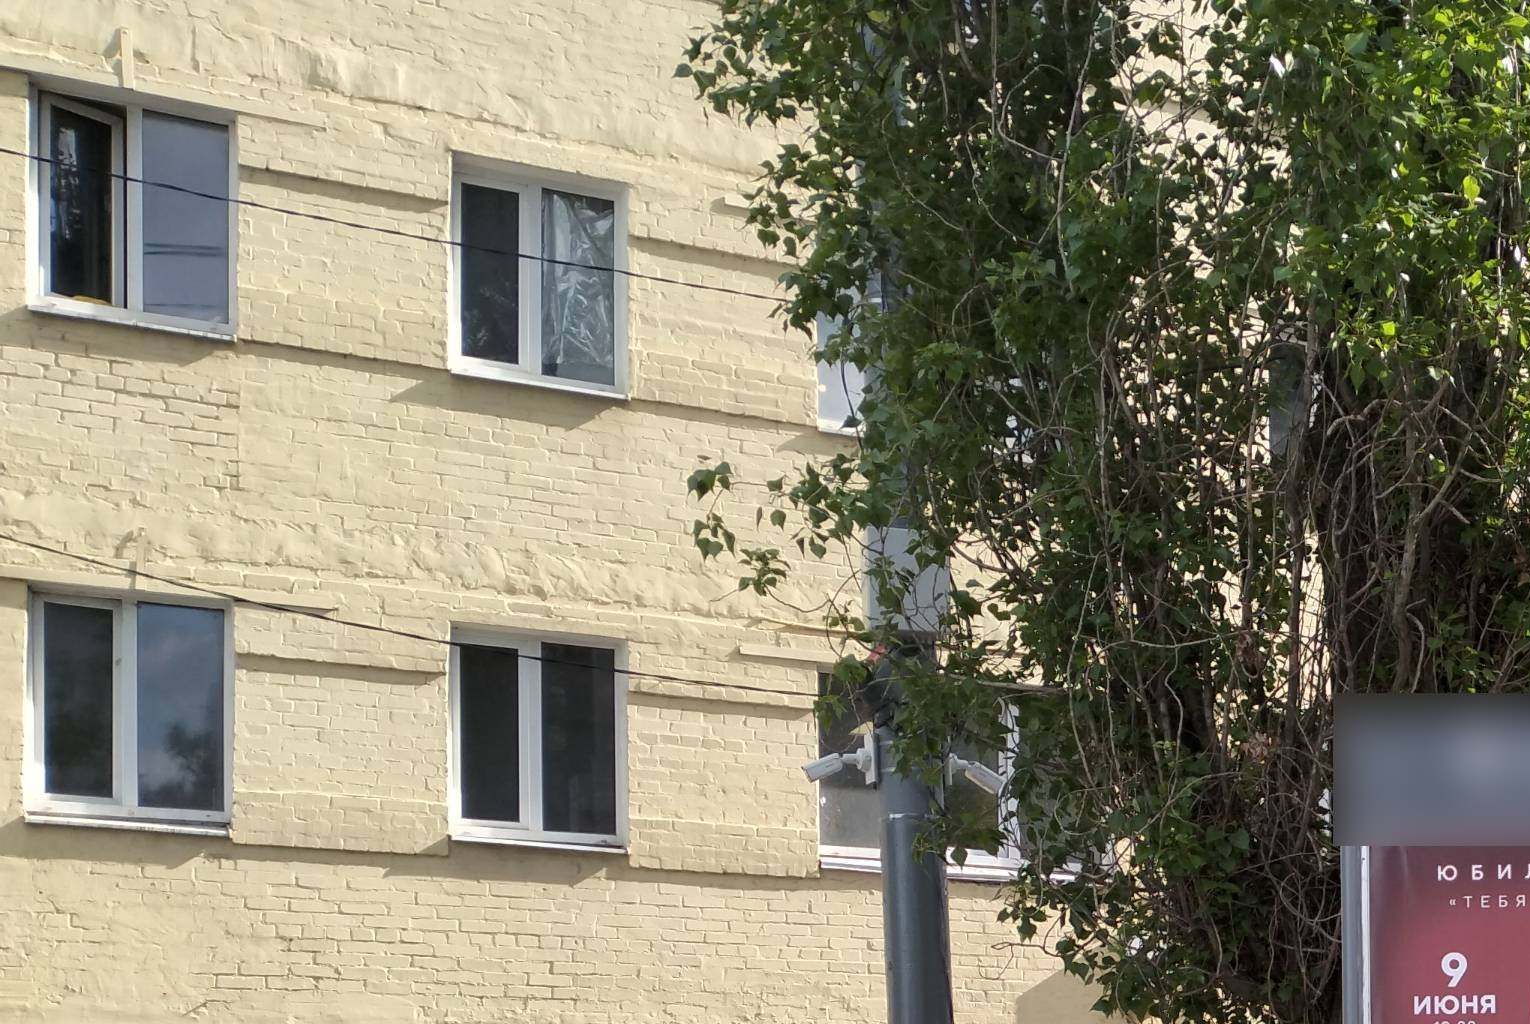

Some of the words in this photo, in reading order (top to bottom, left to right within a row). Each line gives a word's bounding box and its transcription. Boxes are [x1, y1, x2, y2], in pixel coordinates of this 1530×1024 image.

[1449, 894, 1527, 908] «ТЕБЯ
[1441, 952, 1468, 988] 9
[1413, 994, 1497, 1015] ИЮНЯ
